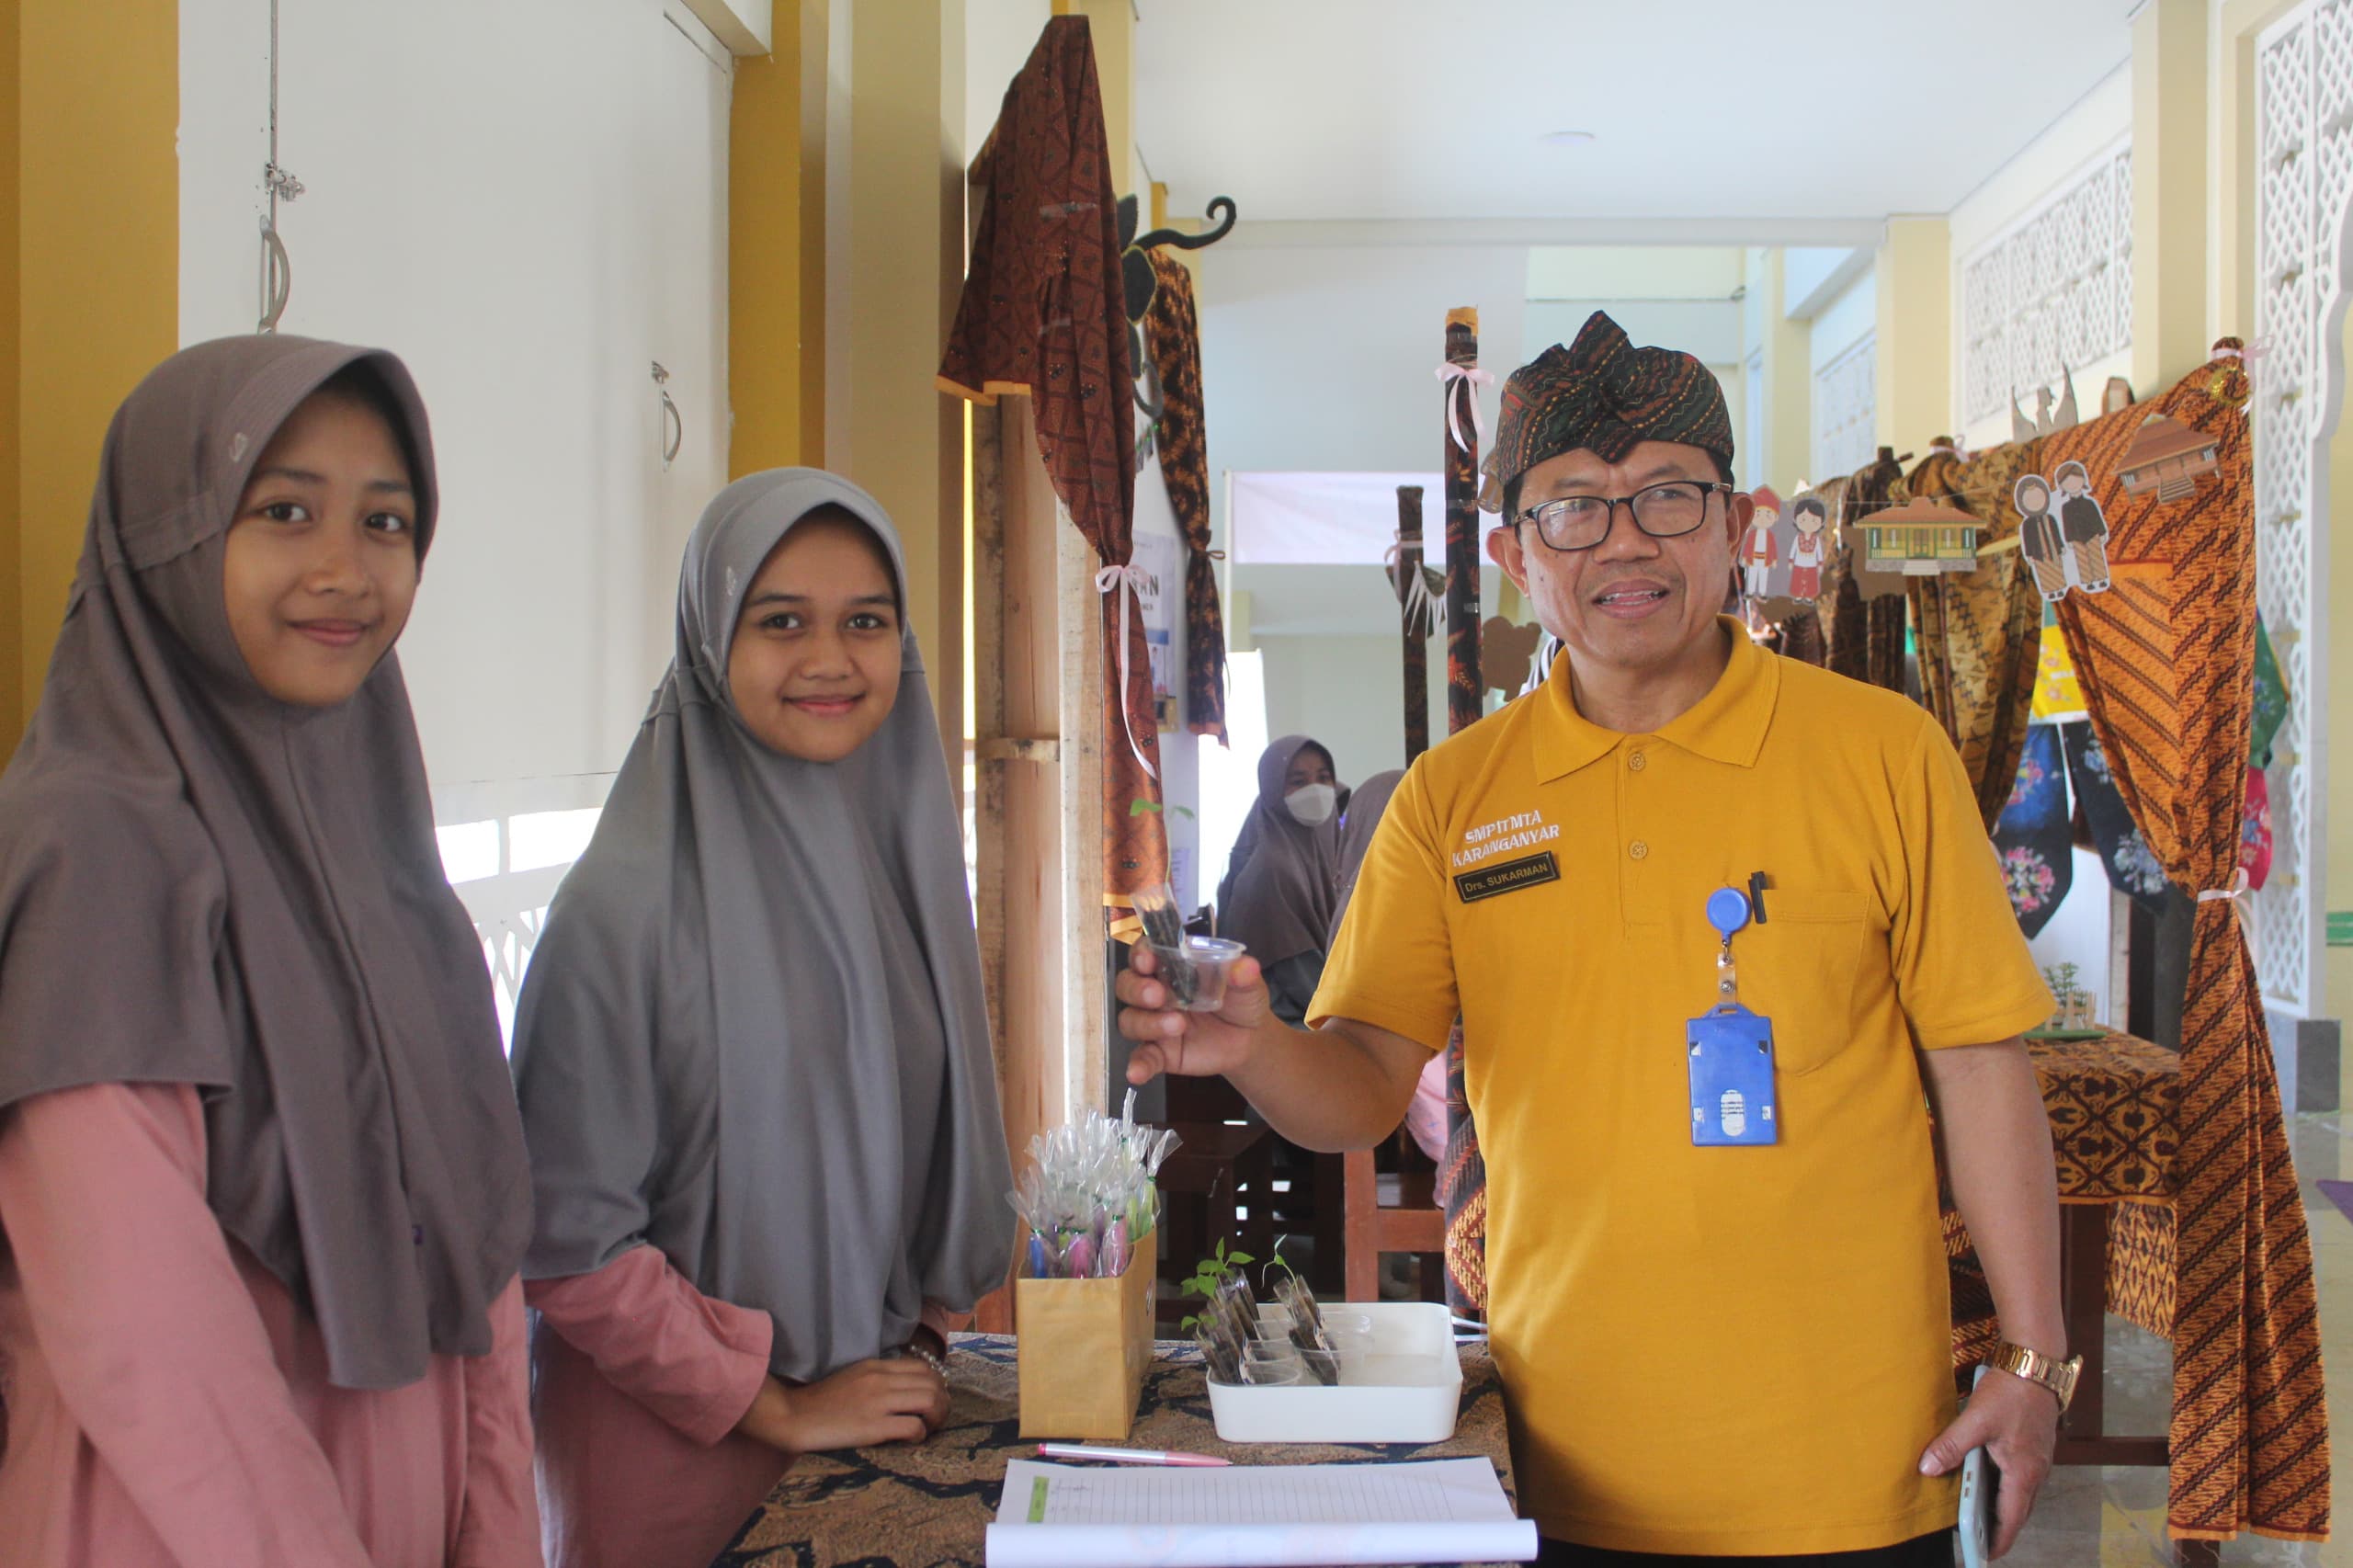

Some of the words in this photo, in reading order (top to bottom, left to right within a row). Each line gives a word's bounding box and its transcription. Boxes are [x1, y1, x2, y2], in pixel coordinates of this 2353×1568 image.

[1452, 824, 1560, 867] KARANGANYAR
[1465, 881, 1486, 892] Drs.
[1486, 862, 1549, 886] SUKARMAN
